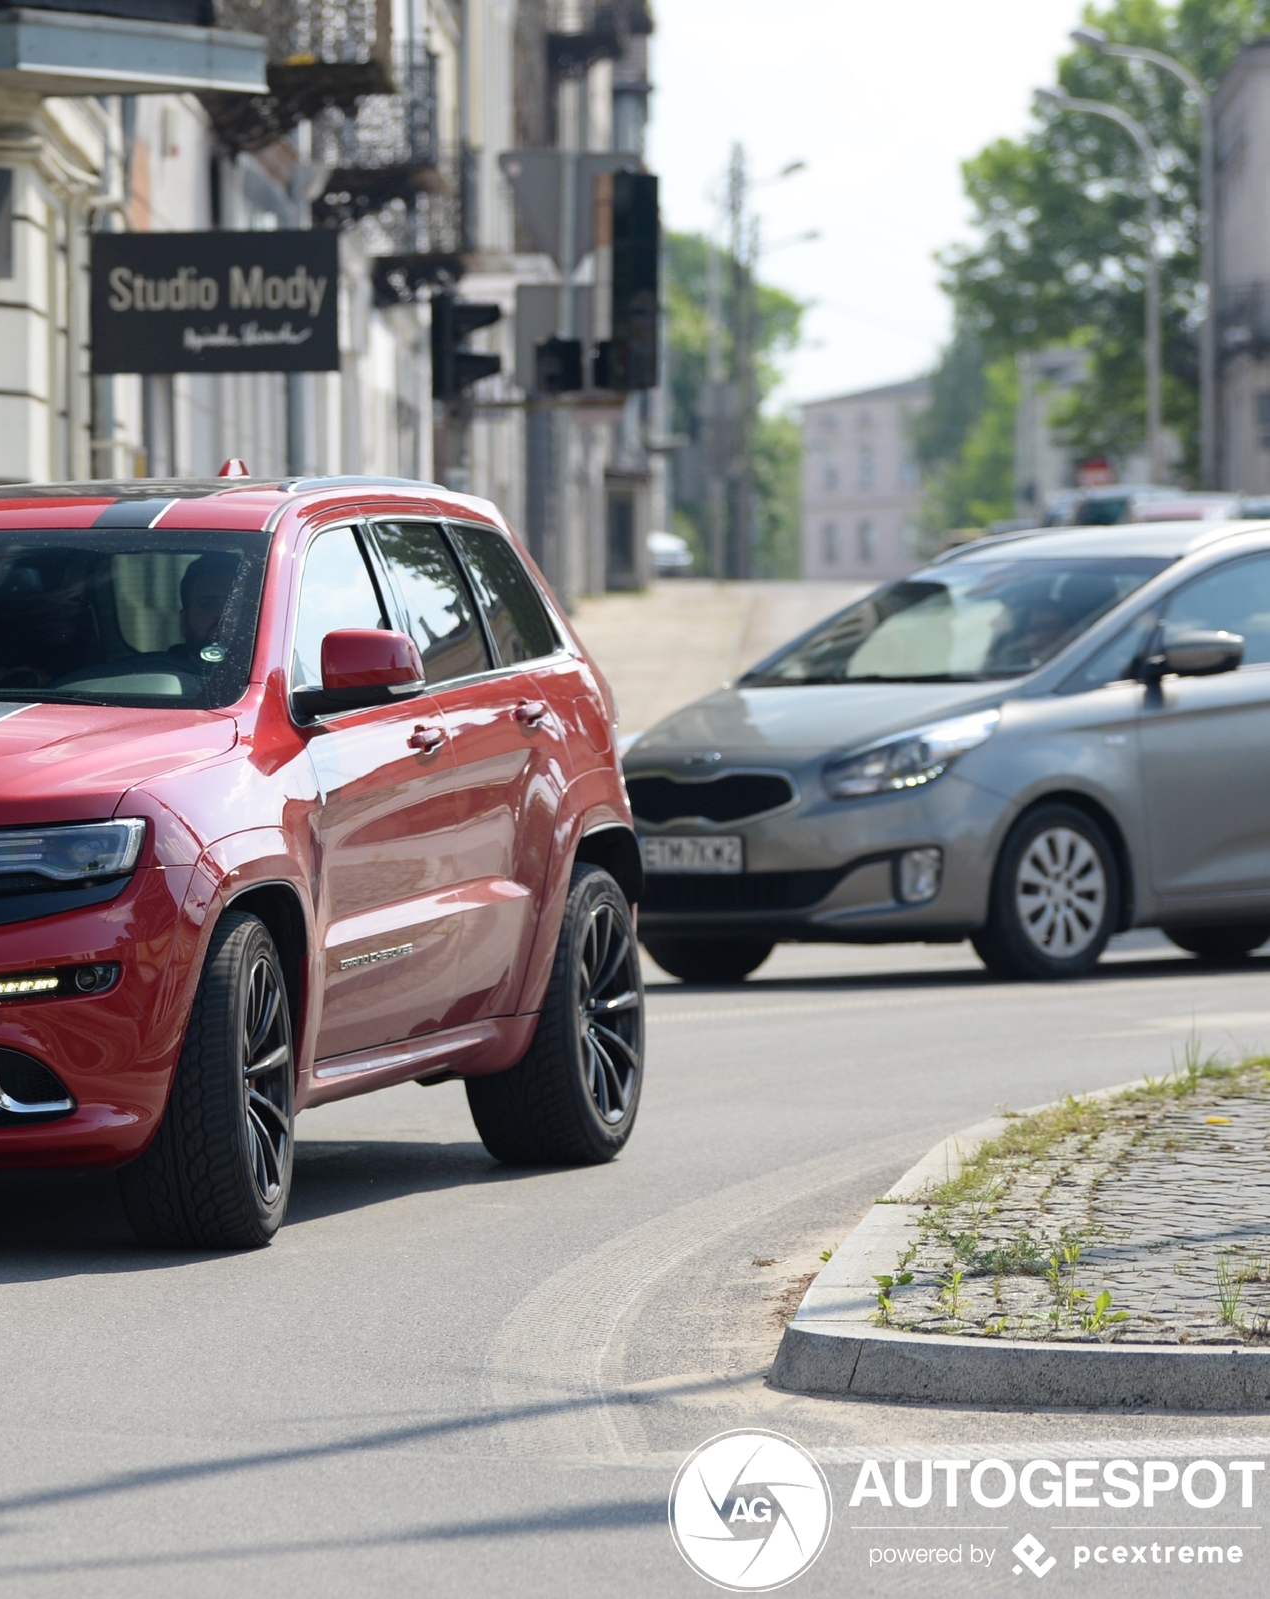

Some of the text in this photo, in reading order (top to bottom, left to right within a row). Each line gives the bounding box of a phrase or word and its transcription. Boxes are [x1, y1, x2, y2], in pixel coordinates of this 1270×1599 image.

[108, 264, 328, 318] Studio Mody
[340, 954, 369, 970] GRAND
